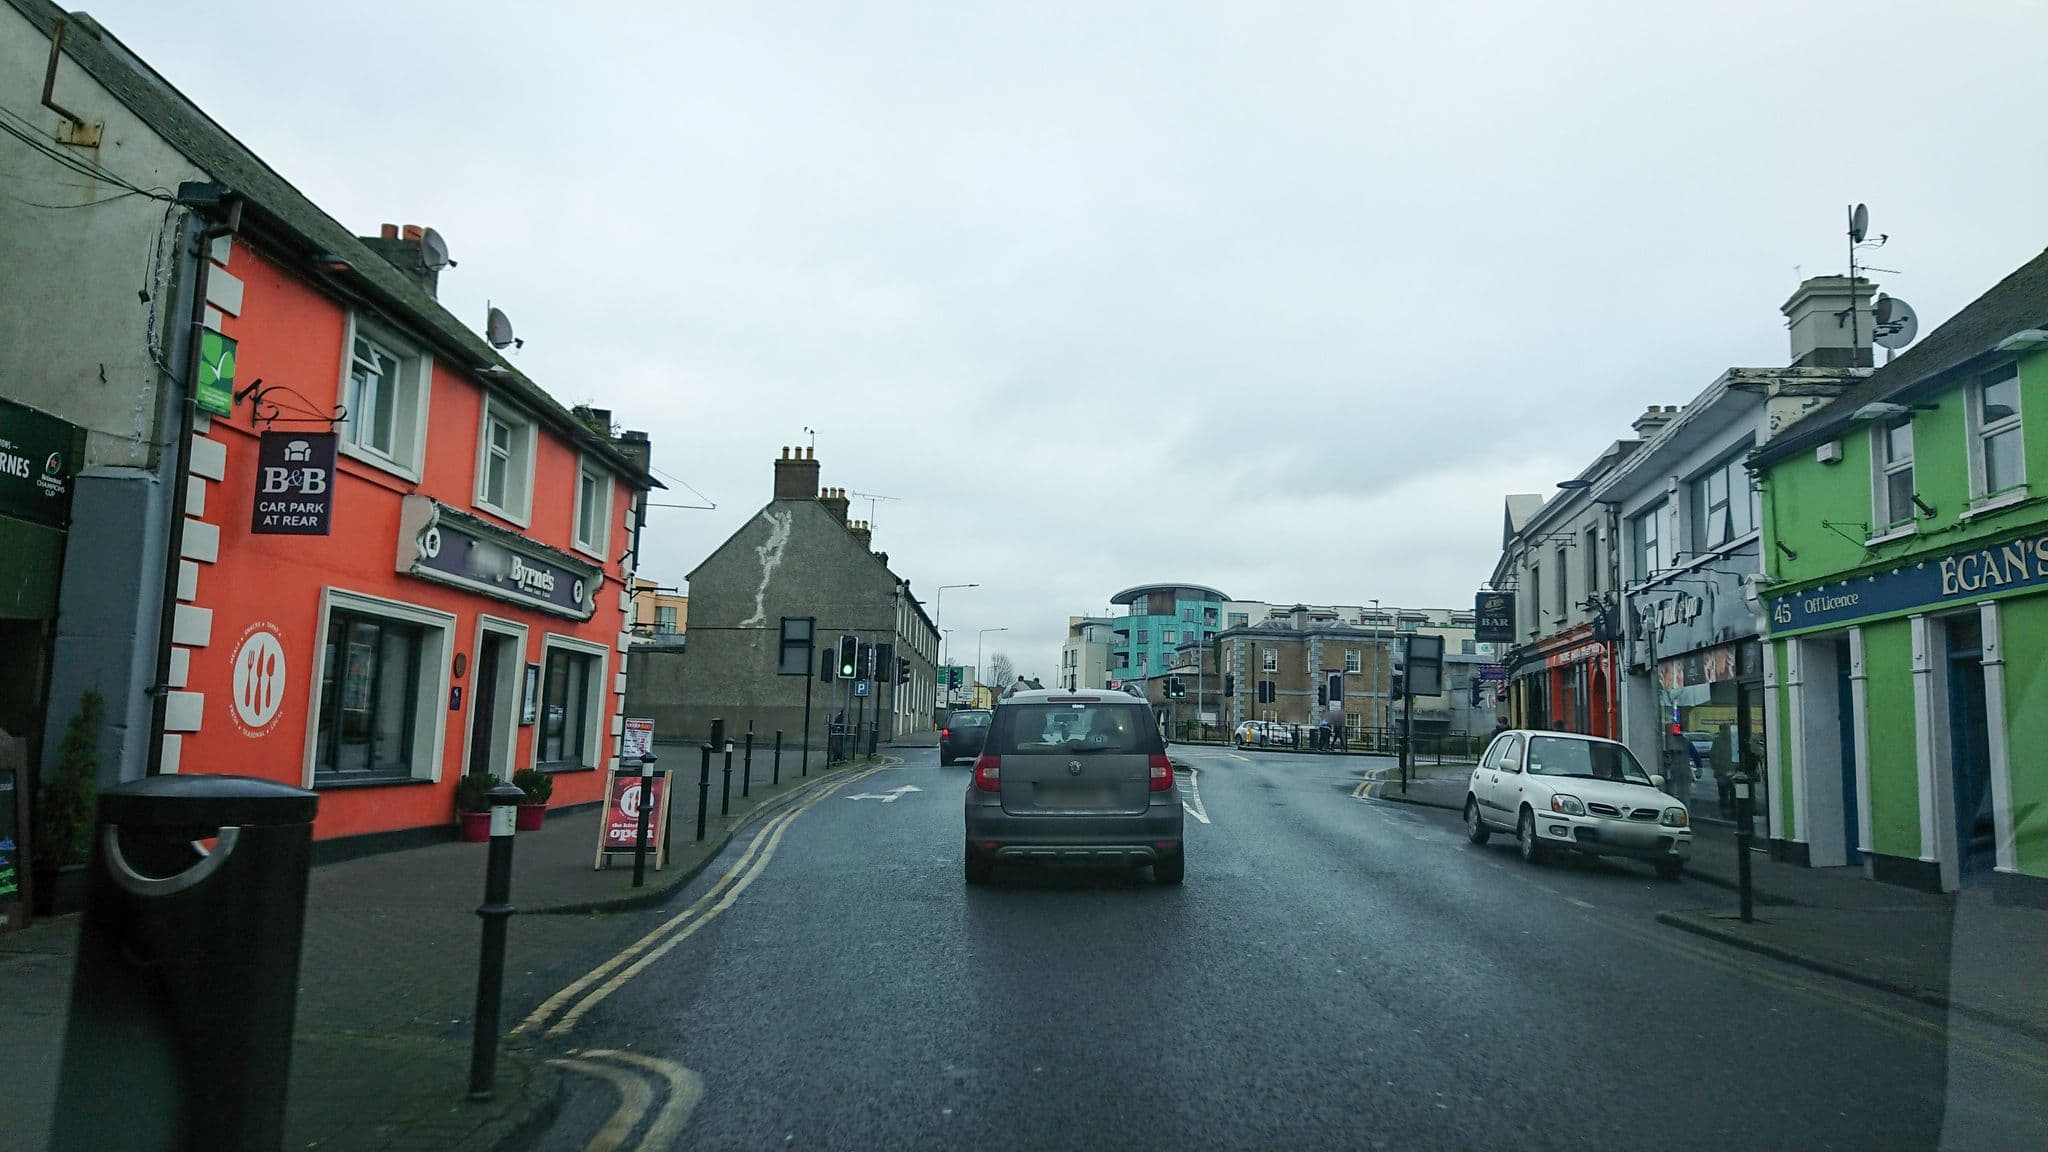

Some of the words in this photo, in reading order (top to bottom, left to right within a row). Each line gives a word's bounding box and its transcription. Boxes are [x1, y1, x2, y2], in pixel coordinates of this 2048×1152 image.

[262, 467, 327, 494] B&B
[259, 502, 286, 513] CAR
[289, 502, 325, 514] PARK
[262, 515, 280, 526] AT
[282, 516, 318, 527] REAR
[510, 554, 555, 592] Byrne's
[1774, 603, 1792, 624] 45
[1804, 597, 1821, 614] Off
[1822, 593, 1860, 611] Licence
[1481, 618, 1509, 627] BAR
[857, 683, 865, 694] P
